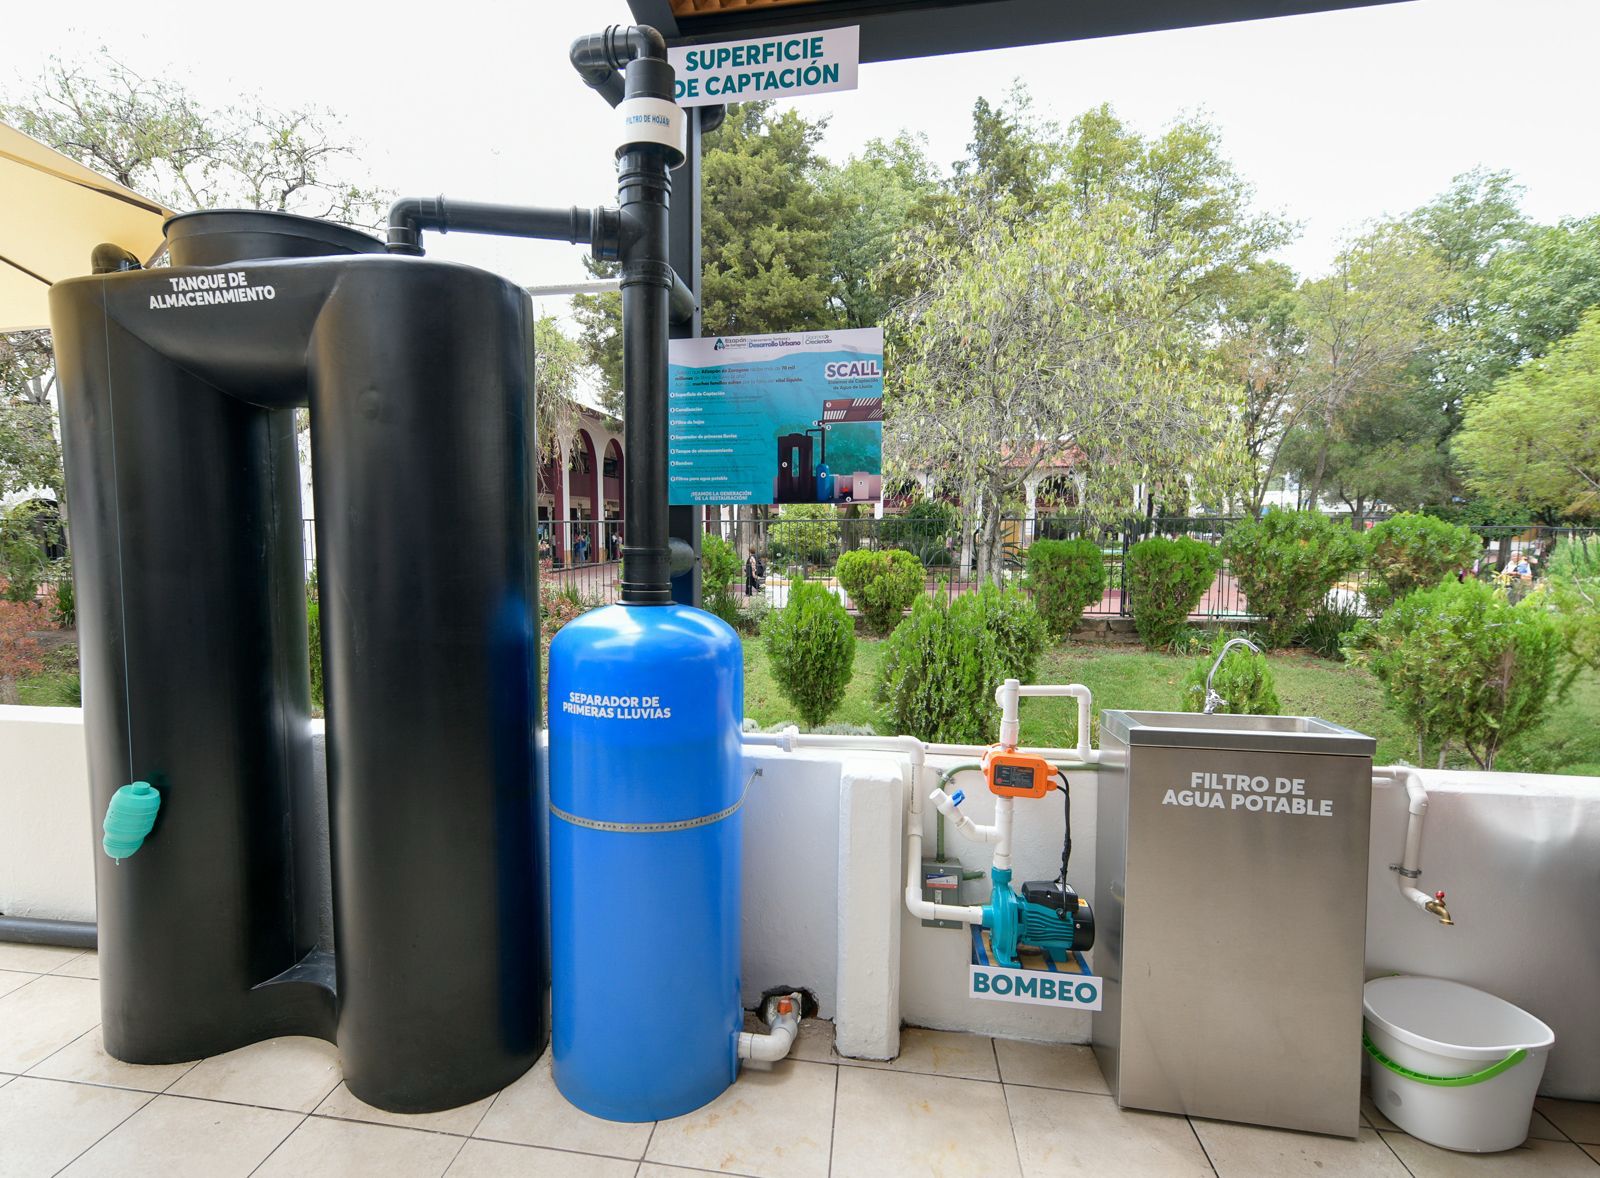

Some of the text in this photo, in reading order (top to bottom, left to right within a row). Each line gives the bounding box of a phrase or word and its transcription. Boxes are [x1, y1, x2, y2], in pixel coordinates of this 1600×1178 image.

[686, 36, 824, 71] SUPERFICIE
[675, 60, 839, 98] DE CAPTACIÓN
[644, 114, 652, 122] DE
[170, 272, 248, 292] TANQUE DE
[150, 286, 276, 309] ALMACENAMIENTO
[826, 362, 880, 378] SCALL
[563, 702, 671, 719] PRIMERAS LLUVIAS
[570, 692, 660, 708] SEPARADOR DE
[1191, 771, 1305, 796] FILTRO DE
[1162, 789, 1333, 816] AGUA POTABLE
[974, 972, 1098, 1003] BOMBEO
